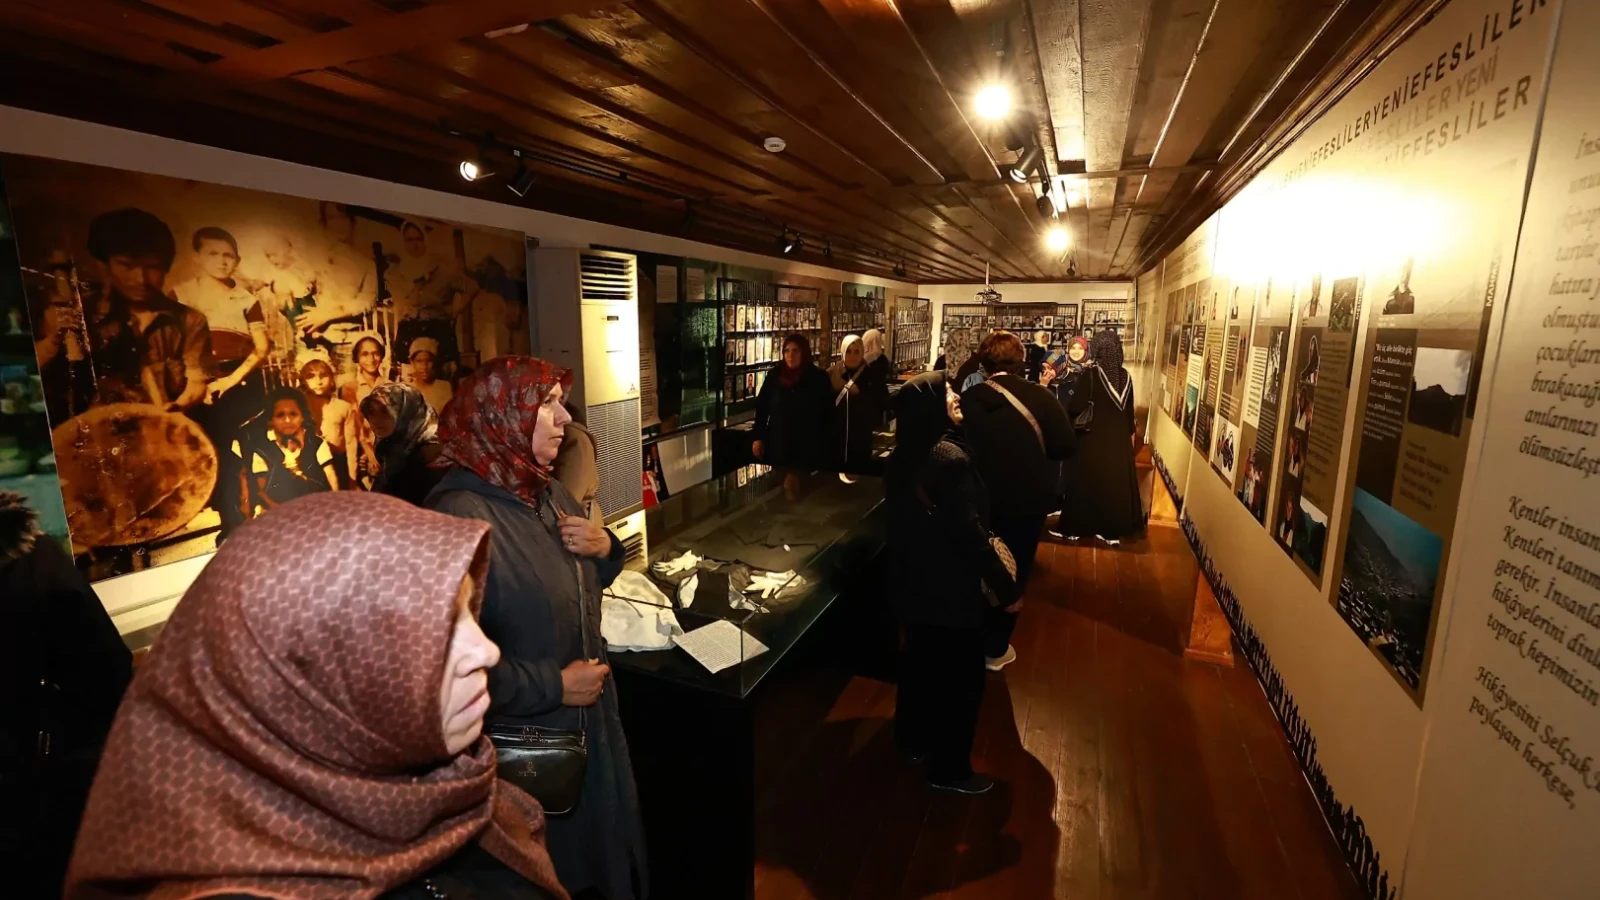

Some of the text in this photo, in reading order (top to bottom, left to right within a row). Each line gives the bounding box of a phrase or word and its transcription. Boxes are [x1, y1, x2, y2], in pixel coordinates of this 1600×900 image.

[1509, 495, 1558, 530] Kentler
[1503, 525, 1558, 565] Kentleri
[1494, 559, 1541, 592] gerekir.
[1487, 611, 1600, 707] toprak hepimizin
[1468, 696, 1576, 811] paylaşan herkese,
[1539, 725, 1594, 790] Selçuk
